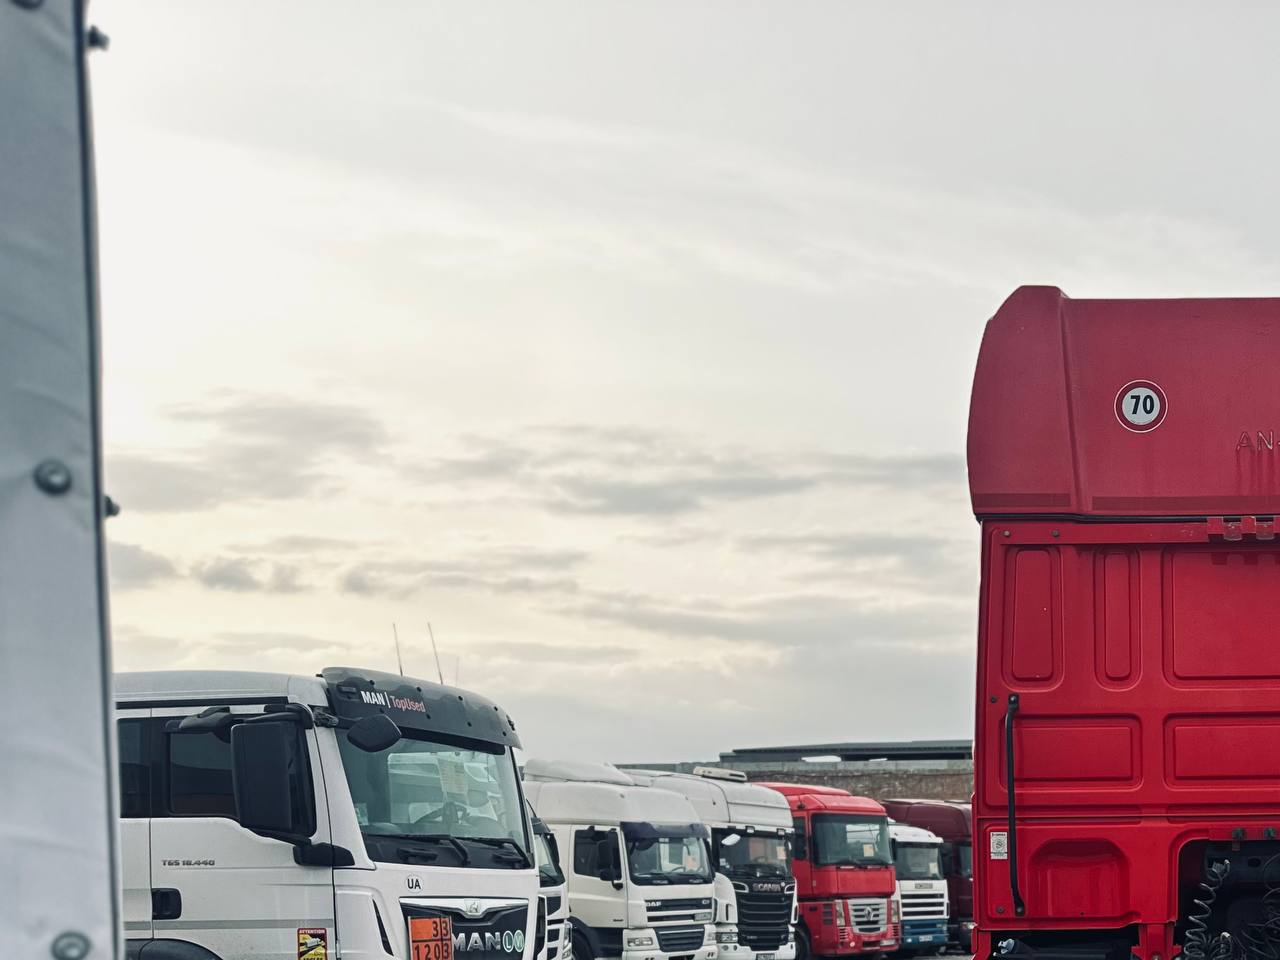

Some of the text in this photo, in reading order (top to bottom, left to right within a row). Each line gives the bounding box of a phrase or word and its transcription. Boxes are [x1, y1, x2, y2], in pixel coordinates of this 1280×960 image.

[1130, 394, 1156, 415] 70
[360, 690, 426, 712] MAN TopUsed
[407, 878, 421, 889] UA
[432, 920, 449, 940] 33
[451, 931, 501, 952] MAN
